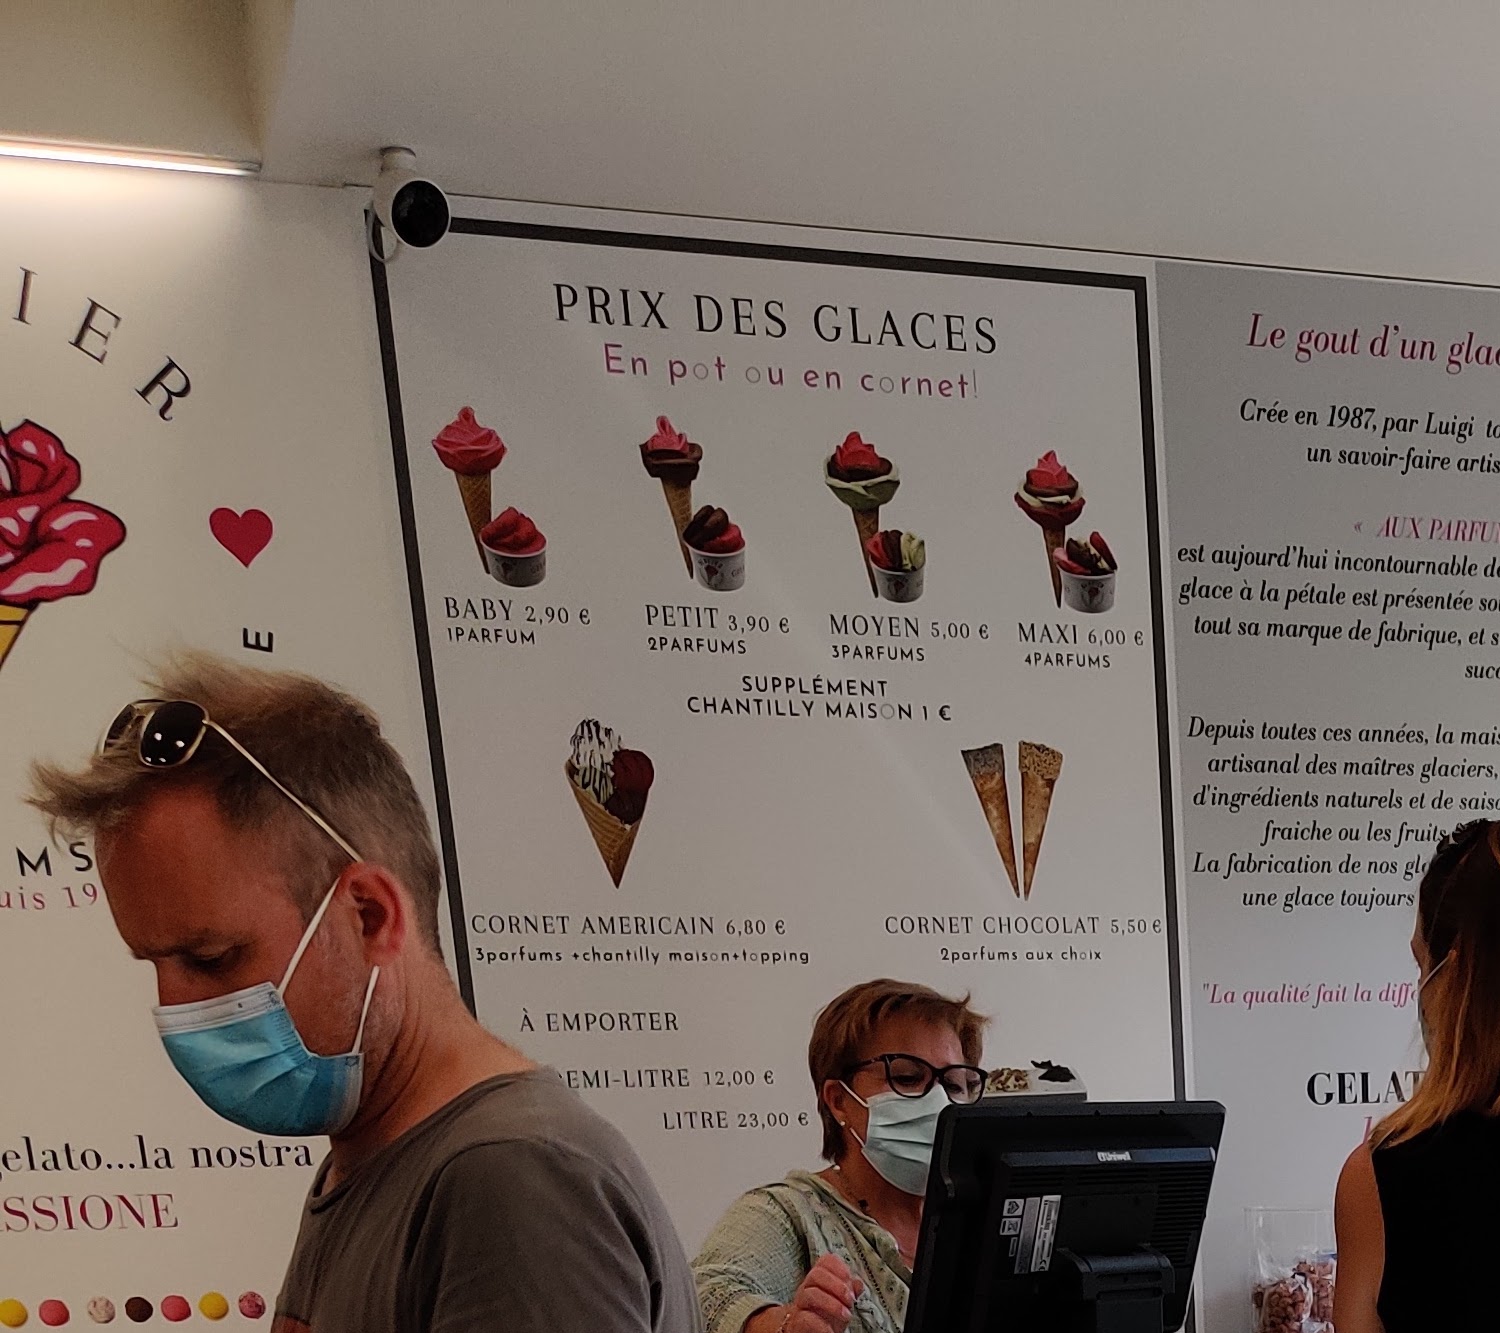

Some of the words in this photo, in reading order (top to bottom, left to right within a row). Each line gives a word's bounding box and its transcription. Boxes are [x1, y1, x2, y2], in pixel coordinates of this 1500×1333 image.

[553, 283, 669, 329] PRIX
[693, 294, 786, 338] DES
[814, 304, 996, 354] GLACES
[1246, 313, 1285, 349] Le
[1295, 328, 1360, 363] gout
[1370, 324, 1437, 361] d'un
[604, 342, 648, 376] En
[668, 355, 726, 386] pot
[745, 366, 783, 386] ou
[804, 369, 841, 391] en
[861, 369, 978, 399] cornet!
[1240, 398, 1288, 424] Crée
[1295, 410, 1319, 426] en
[1327, 405, 1377, 433] 1987,
[1381, 417, 1419, 439] par
[1424, 412, 1474, 444] Luigi
[1307, 447, 1332, 463] un
[1338, 446, 1450, 475] savoir-faire
[1376, 516, 1423, 539] AUX
[1177, 544, 1205, 563] est
[1211, 544, 1328, 572] aujourd'hui
[1335, 549, 1478, 577] incontournable
[1178, 576, 1233, 605] glace
[1284, 582, 1346, 610] pétale
[1352, 589, 1378, 607] est
[1382, 587, 1473, 615] présentée
[444, 597, 513, 625] BABY
[525, 606, 569, 625] 2,90
[645, 604, 718, 629] PETIT
[728, 615, 769, 634] 3,90
[829, 614, 919, 638] MOYEN
[931, 622, 969, 640] 5,00
[1018, 622, 1077, 644] MAXI
[1088, 629, 1125, 646] 6,00
[1194, 615, 1232, 635] tout
[1237, 622, 1261, 636] sa
[1267, 623, 1342, 646] marque
[1348, 619, 1371, 641] de
[1374, 620, 1461, 651] fabrique,
[648, 636, 746, 654] 2PARFUMS
[832, 644, 924, 661] 3PARFUMS
[1024, 652, 1110, 668] 4PARFUMS
[742, 674, 887, 697] SUPPLÉMENT
[687, 696, 814, 717] CHANTILLY
[826, 701, 912, 720] MAISON
[1187, 716, 1254, 746] Depuis
[1261, 722, 1316, 741] toutes
[1323, 728, 1352, 742] ces
[1358, 723, 1428, 745] années,
[1208, 753, 1300, 774] artisanal
[1305, 753, 1337, 775] des
[1343, 756, 1414, 776] maîtres
[1420, 756, 1498, 784] glaciers,
[1193, 784, 1319, 813] d'ingrédients
[1326, 788, 1403, 809] naturels
[1431, 789, 1453, 810] de
[1260, 819, 1332, 847] fraiche
[1338, 828, 1360, 841] ou
[1367, 821, 1391, 841] les
[1394, 821, 1447, 848] fruits
[1192, 852, 1220, 873] La
[1223, 852, 1332, 879] fabrication
[1338, 853, 1361, 874] de
[1368, 861, 1398, 874] nos
[1243, 893, 1277, 906] une
[1283, 886, 1334, 913] glace
[1341, 887, 1414, 913] toujours
[472, 915, 569, 934] CORNET
[581, 916, 713, 935] AMERICAIN
[726, 919, 765, 937] 6,80
[885, 916, 973, 934] CORNET
[983, 916, 1099, 934] CHOCOLAT
[1111, 919, 1146, 935] 5,50
[476, 945, 562, 965] 3parfums
[941, 946, 1017, 964] 2parfums
[1026, 952, 1053, 960] aux
[1061, 946, 1101, 960] choix
[1243, 983, 1311, 1010] qualité
[1312, 983, 1347, 1008] fait
[520, 1008, 535, 1032] À
[546, 1012, 678, 1032] EMPORTER
[559, 1068, 690, 1089] EMI-LITRE
[704, 1070, 754, 1087] 12,00
[663, 1111, 728, 1130] LITRE
[737, 1112, 788, 1129] 23,00
[0, 1135, 174, 1178] elato...la
[189, 1139, 314, 1169] nostra
[0, 1193, 178, 1232] SSIONE
